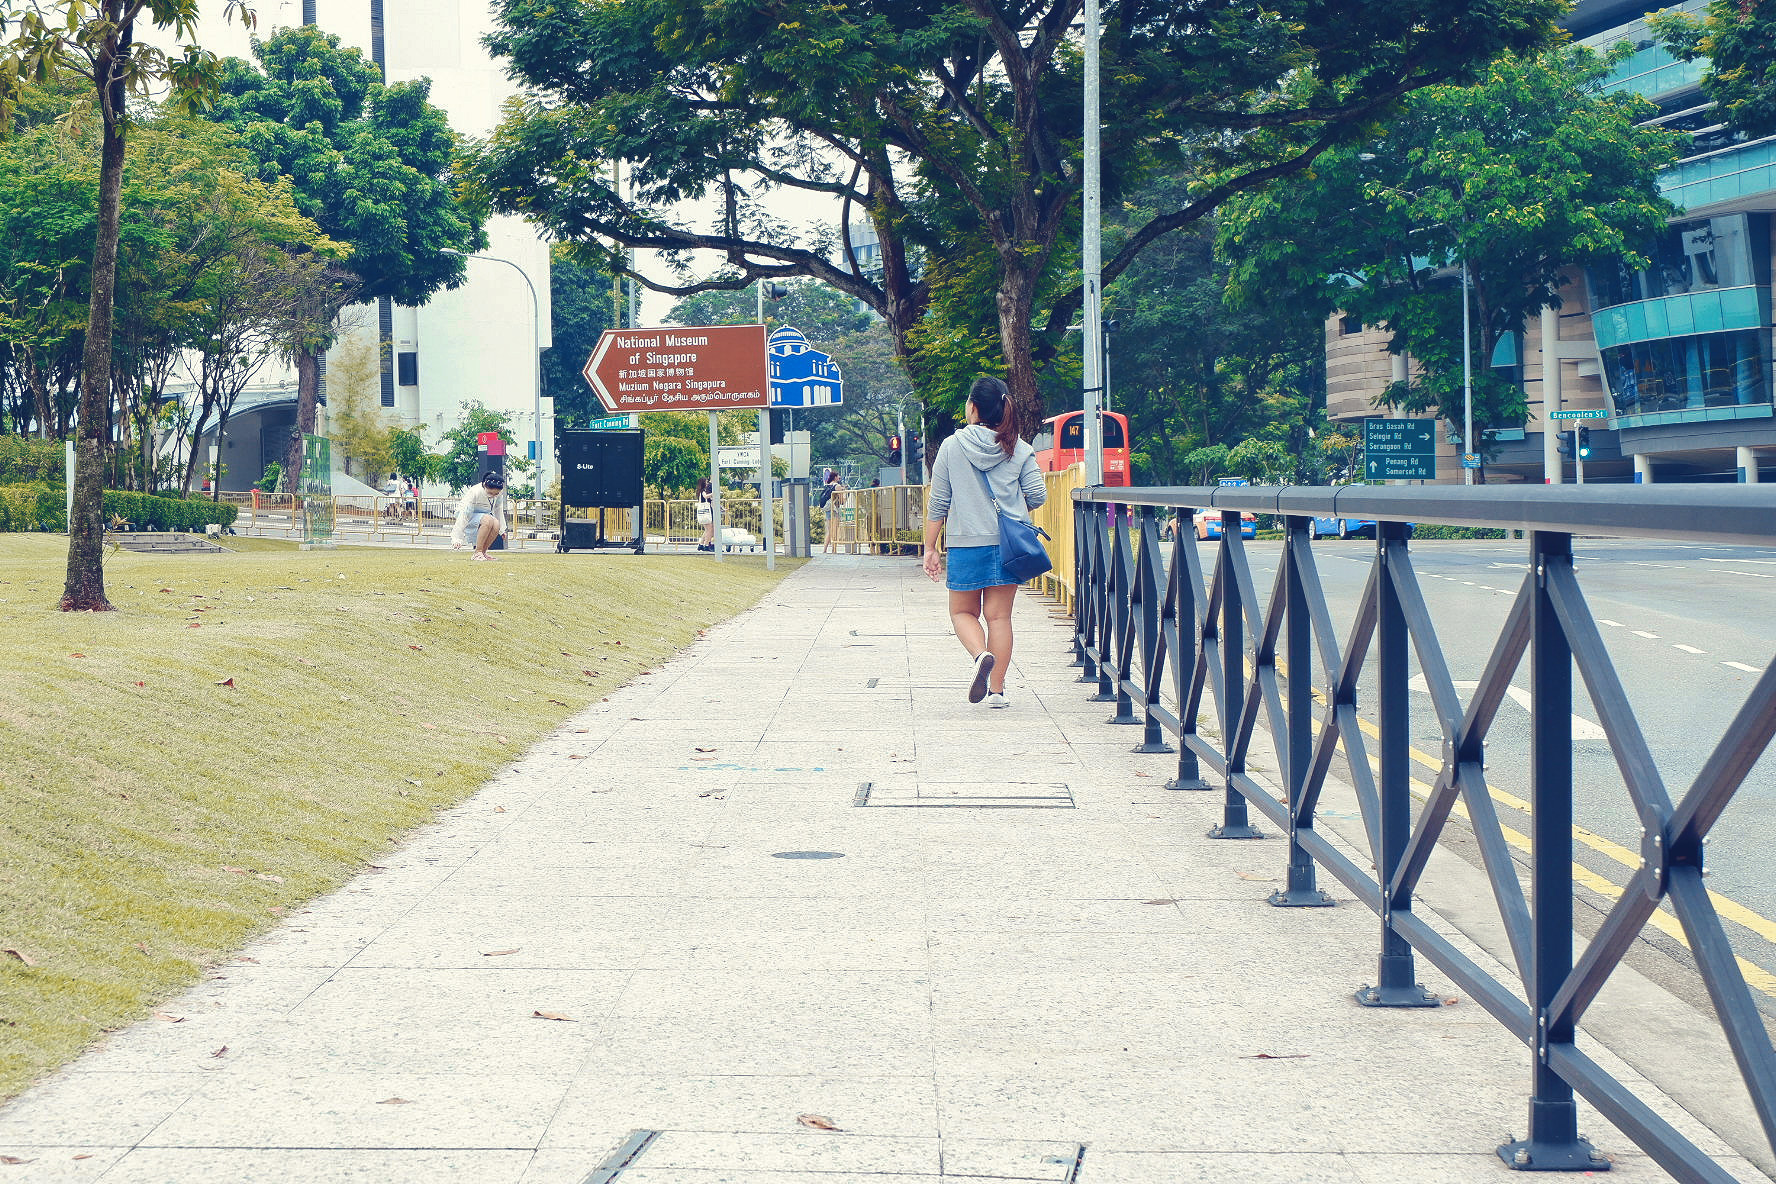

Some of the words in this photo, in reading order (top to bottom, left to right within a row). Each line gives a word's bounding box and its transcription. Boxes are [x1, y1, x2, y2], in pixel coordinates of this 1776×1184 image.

[617, 335, 660, 349] National
[665, 335, 708, 347] Museum
[629, 353, 640, 365] of
[646, 352, 697, 366] Singapore
[618, 367, 694, 379] 新加坡国家博物馆
[619, 382, 649, 392] Muzium
[653, 381, 682, 391] Negara
[686, 379, 726, 390] Singapura
[1553, 411, 1593, 419] Bencoolen
[1595, 410, 1604, 418] St
[1069, 425, 1080, 436] 147
[1369, 422, 1383, 430] Bras
[1386, 422, 1405, 430] Basah
[1407, 422, 1415, 430] Rd
[1369, 432, 1391, 442] Selegie
[1394, 432, 1402, 440] Rd
[1369, 442, 1401, 452] Serangoon
[1403, 442, 1412, 450] Rd
[1385, 457, 1408, 467] Penang
[1410, 457, 1419, 465] Rd
[1385, 467, 1416, 475] Somerset
[1418, 467, 1427, 475] Rd
